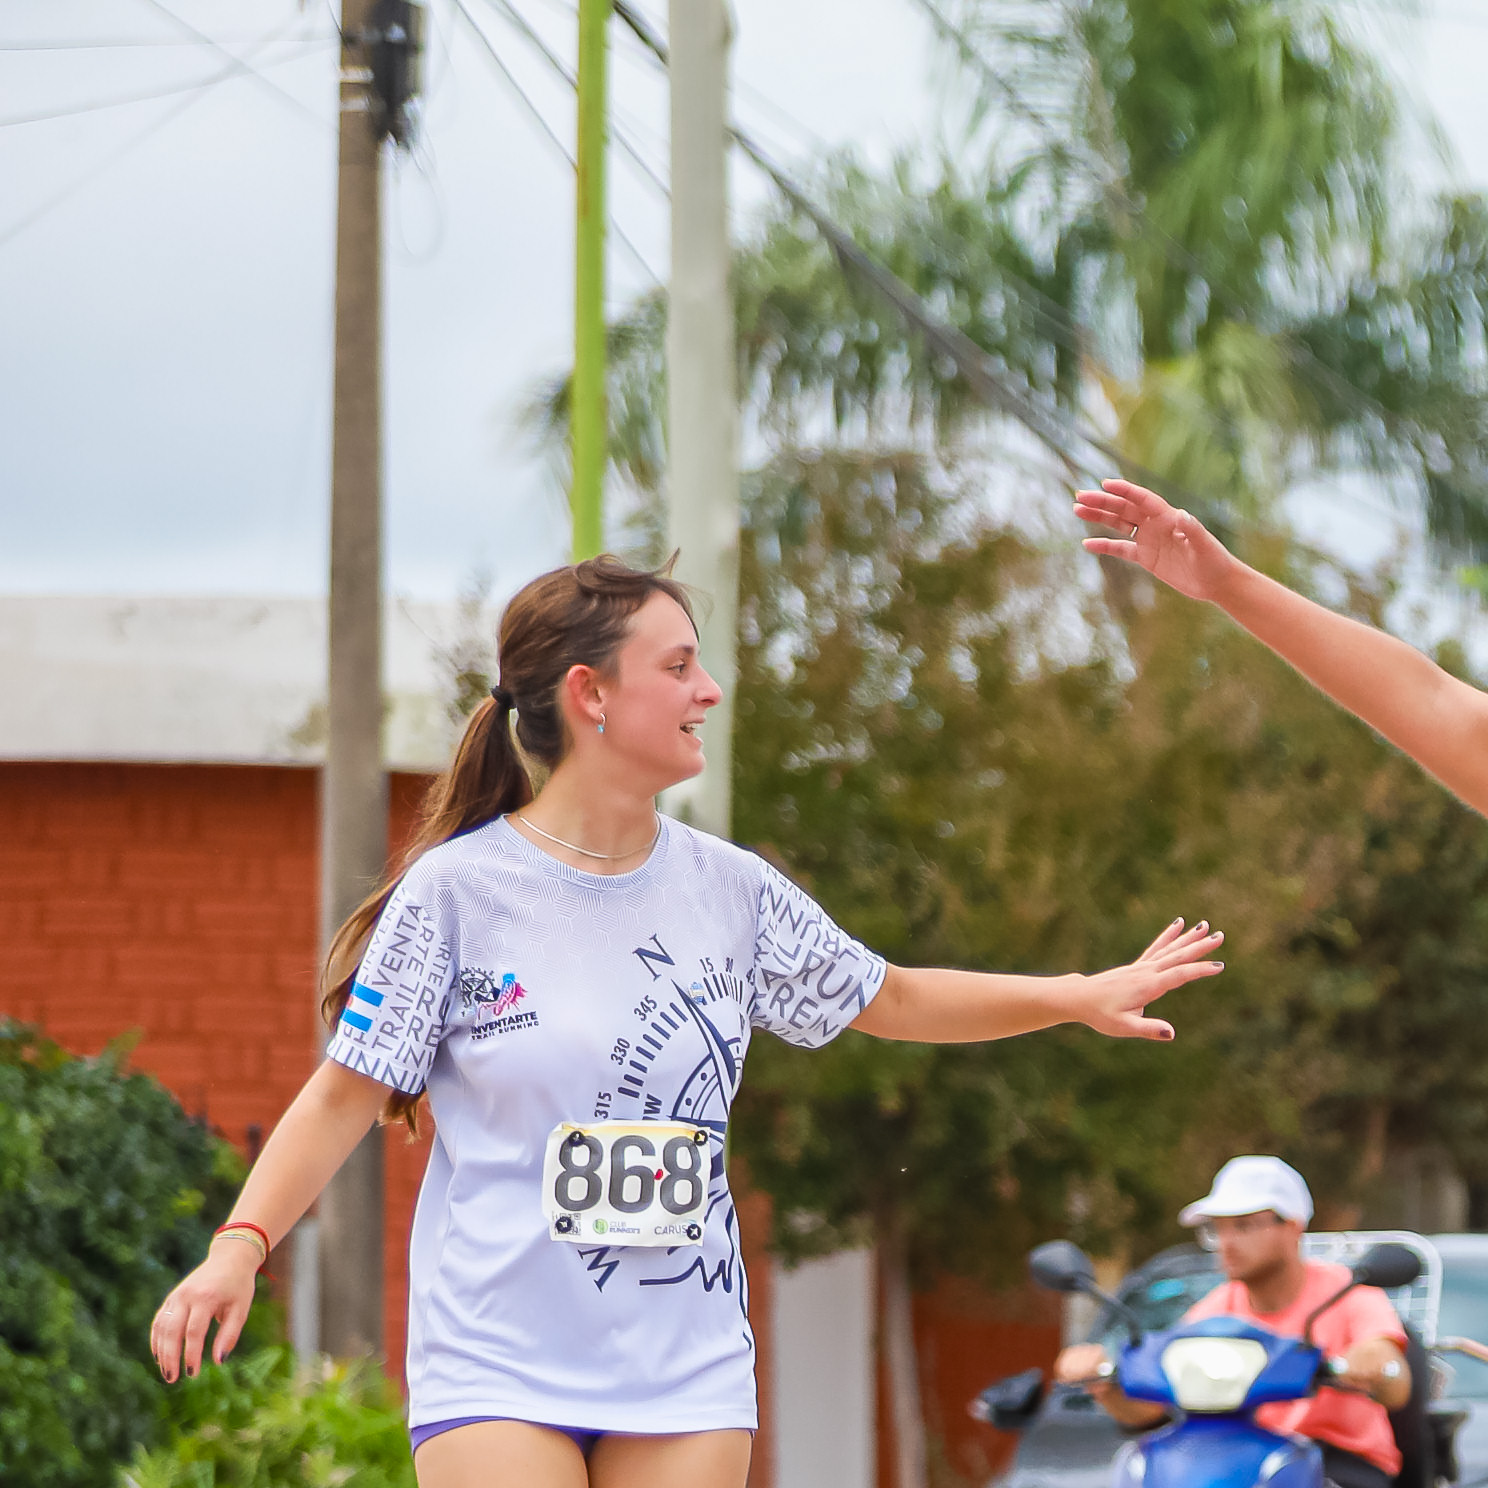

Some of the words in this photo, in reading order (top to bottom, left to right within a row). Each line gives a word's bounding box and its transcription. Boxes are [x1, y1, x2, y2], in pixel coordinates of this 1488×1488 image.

[699, 957, 714, 974] 15
[371, 981, 420, 1051] TRAIL
[634, 995, 658, 1021] 345
[471, 1011, 538, 1035] INVENTARTE
[610, 1037, 630, 1066] 330
[594, 1091, 612, 1120] 315
[555, 1135, 703, 1215] 868
[654, 1225, 690, 1235] CARUS
